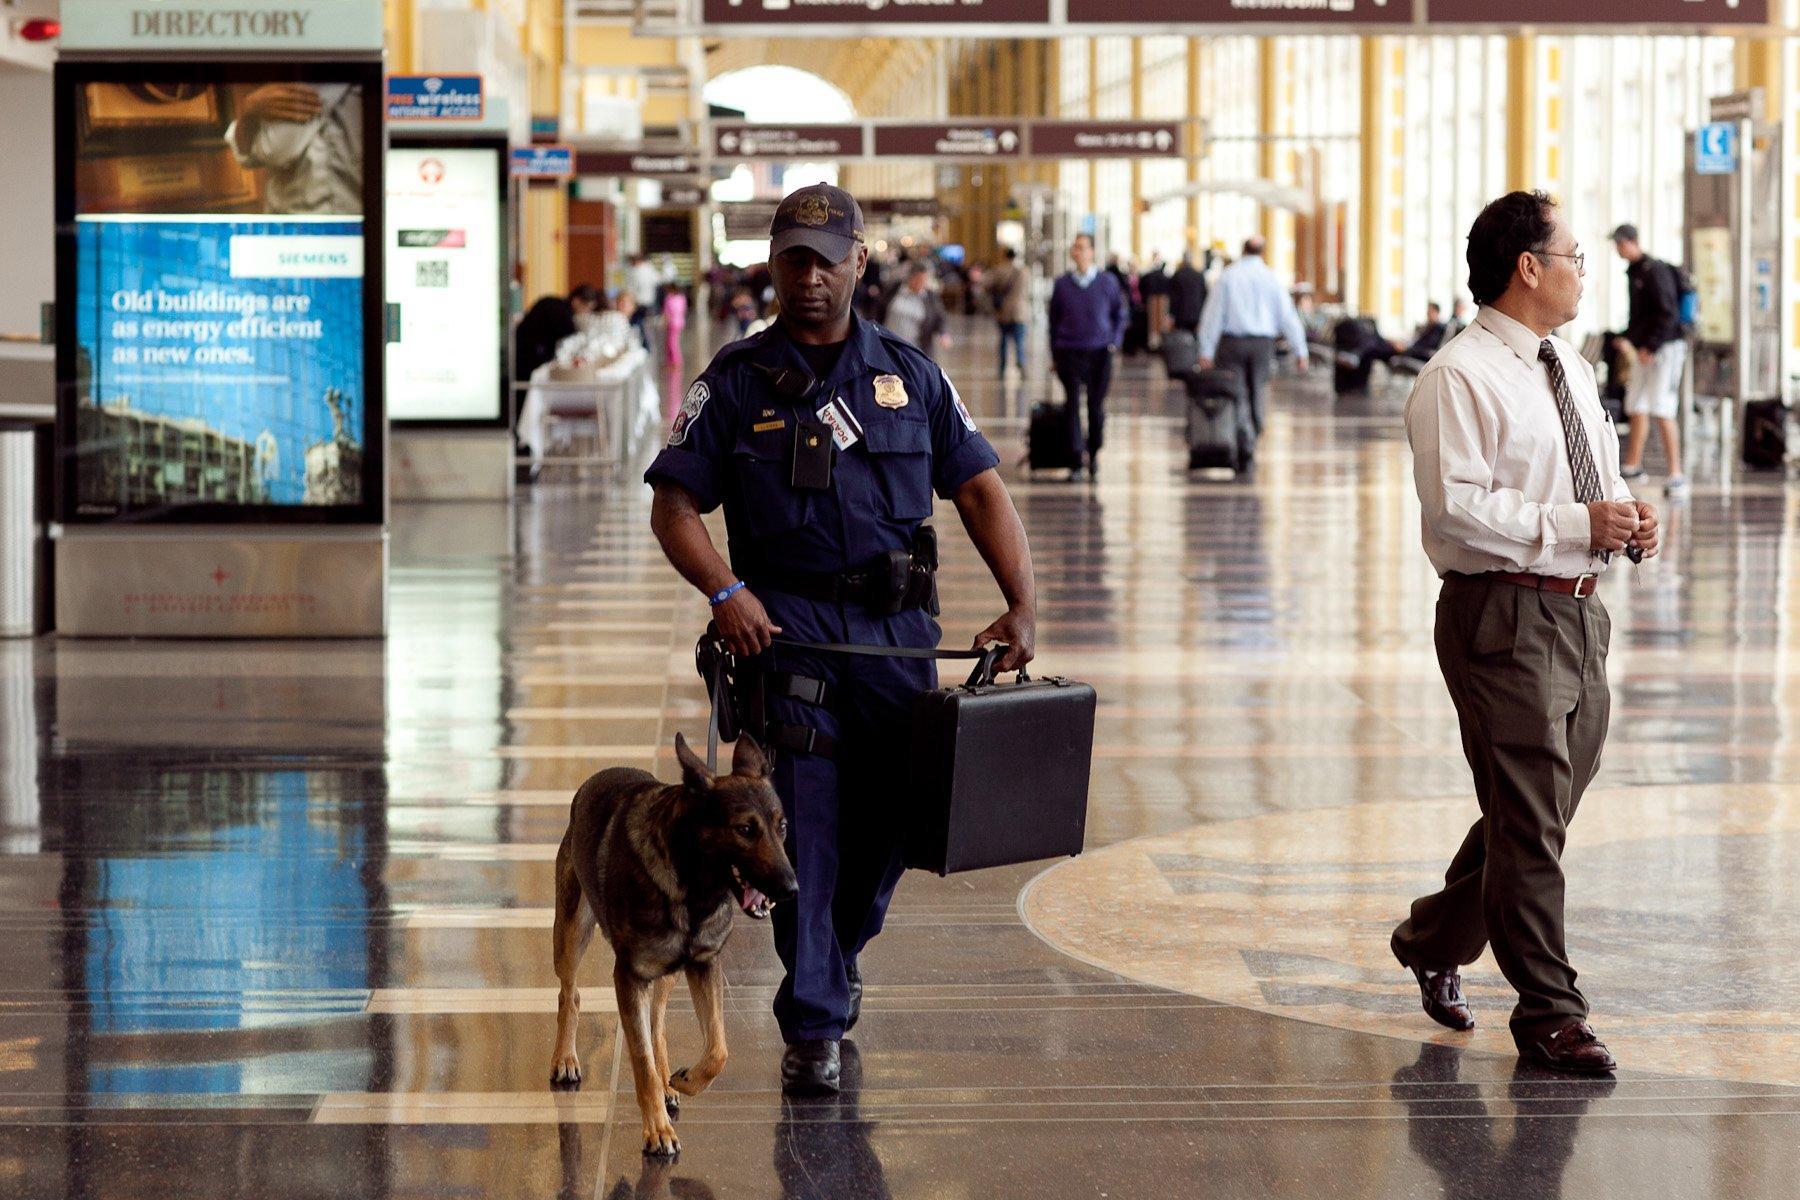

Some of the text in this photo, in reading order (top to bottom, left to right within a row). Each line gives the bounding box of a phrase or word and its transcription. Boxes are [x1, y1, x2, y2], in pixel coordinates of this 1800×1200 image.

[131, 8, 309, 37] DIRECTORY
[416, 89, 480, 105] wireless
[278, 252, 348, 266] SIEMENS
[112, 289, 311, 317] Old buildings are
[112, 316, 322, 343] as energy efficient
[112, 347, 255, 364] as new ones.
